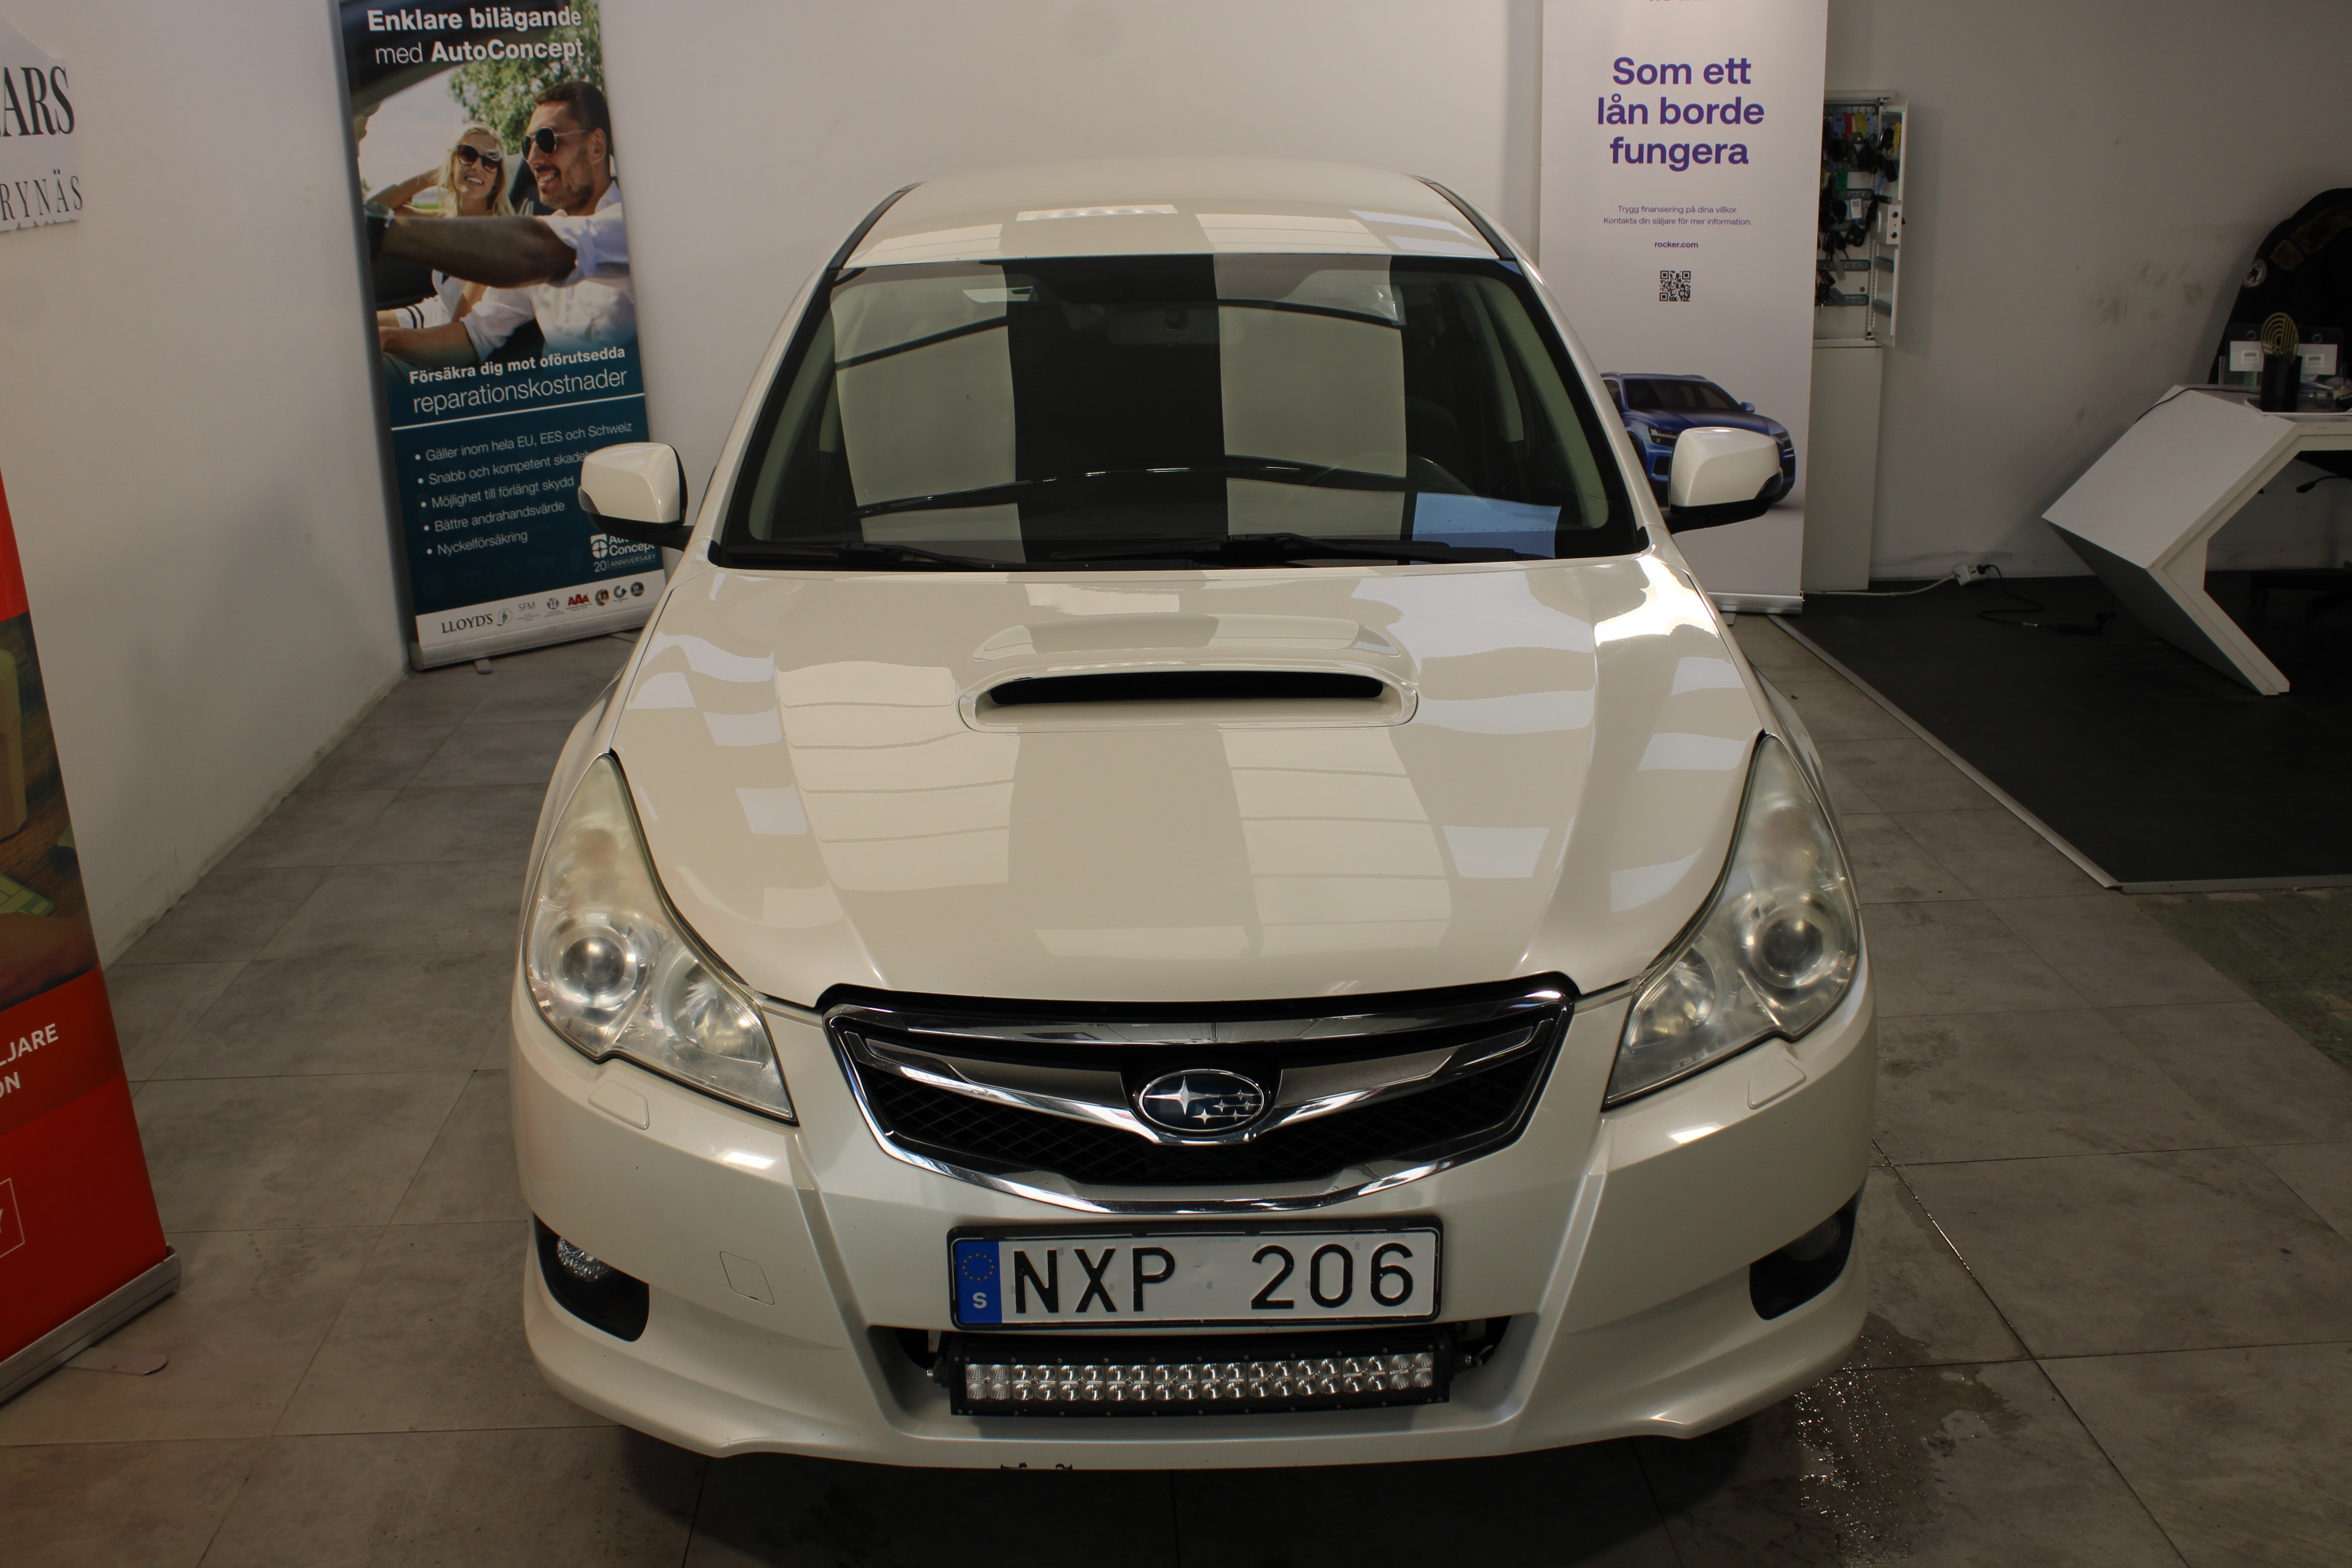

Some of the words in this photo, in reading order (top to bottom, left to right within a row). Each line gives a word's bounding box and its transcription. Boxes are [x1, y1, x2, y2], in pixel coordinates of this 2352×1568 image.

[367, 9, 464, 32] Enklare
[469, 6, 582, 32] bilägande
[375, 41, 424, 65] med
[431, 38, 585, 62] AutoConcept
[1612, 56, 1692, 85] Som
[1703, 58, 1751, 85] ett
[0, 66, 75, 138] ARS
[1597, 92, 1649, 125] lån
[1660, 96, 1765, 125] borde
[1609, 136, 1750, 172] fungera
[1619, 205, 1639, 214] Trygg
[1641, 205, 1684, 214] finansiering
[1686, 205, 1696, 214] på
[1652, 217, 1676, 226] säljare
[1707, 217, 1752, 226] information.
[409, 366, 476, 385] Försäkra
[480, 362, 503, 376] dig
[507, 356, 537, 372] mot
[540, 346, 625, 368] oförutsedda
[413, 368, 628, 416] reparationskostnader
[425, 448, 458, 462] Gäller
[461, 444, 489, 456] inom
[491, 439, 514, 452] hela
[517, 435, 538, 447] EU,
[540, 431, 564, 444] EES
[565, 428, 586, 440] och
[588, 421, 633, 437] Schweiz
[428, 469, 466, 485] Snabb
[469, 466, 490, 479] och
[492, 456, 552, 475] kompetent
[432, 492, 482, 509] Möjlighet
[484, 488, 496, 500] till
[498, 482, 540, 499] förlängt
[542, 476, 575, 492] skydd
[435, 518, 469, 533] Bättre
[471, 501, 565, 526] andrahandsvärde
[437, 531, 528, 556] Nyckelförsäkring
[593, 560, 607, 573] 20
[610, 553, 656, 567] ANNIVERSARY
[441, 612, 493, 634] LLOYD'S
[518, 601, 536, 612] SFM
[973, 1292, 987, 1309] S
[1013, 1246, 1176, 1314] NXP
[1250, 1243, 1414, 1310] 206
